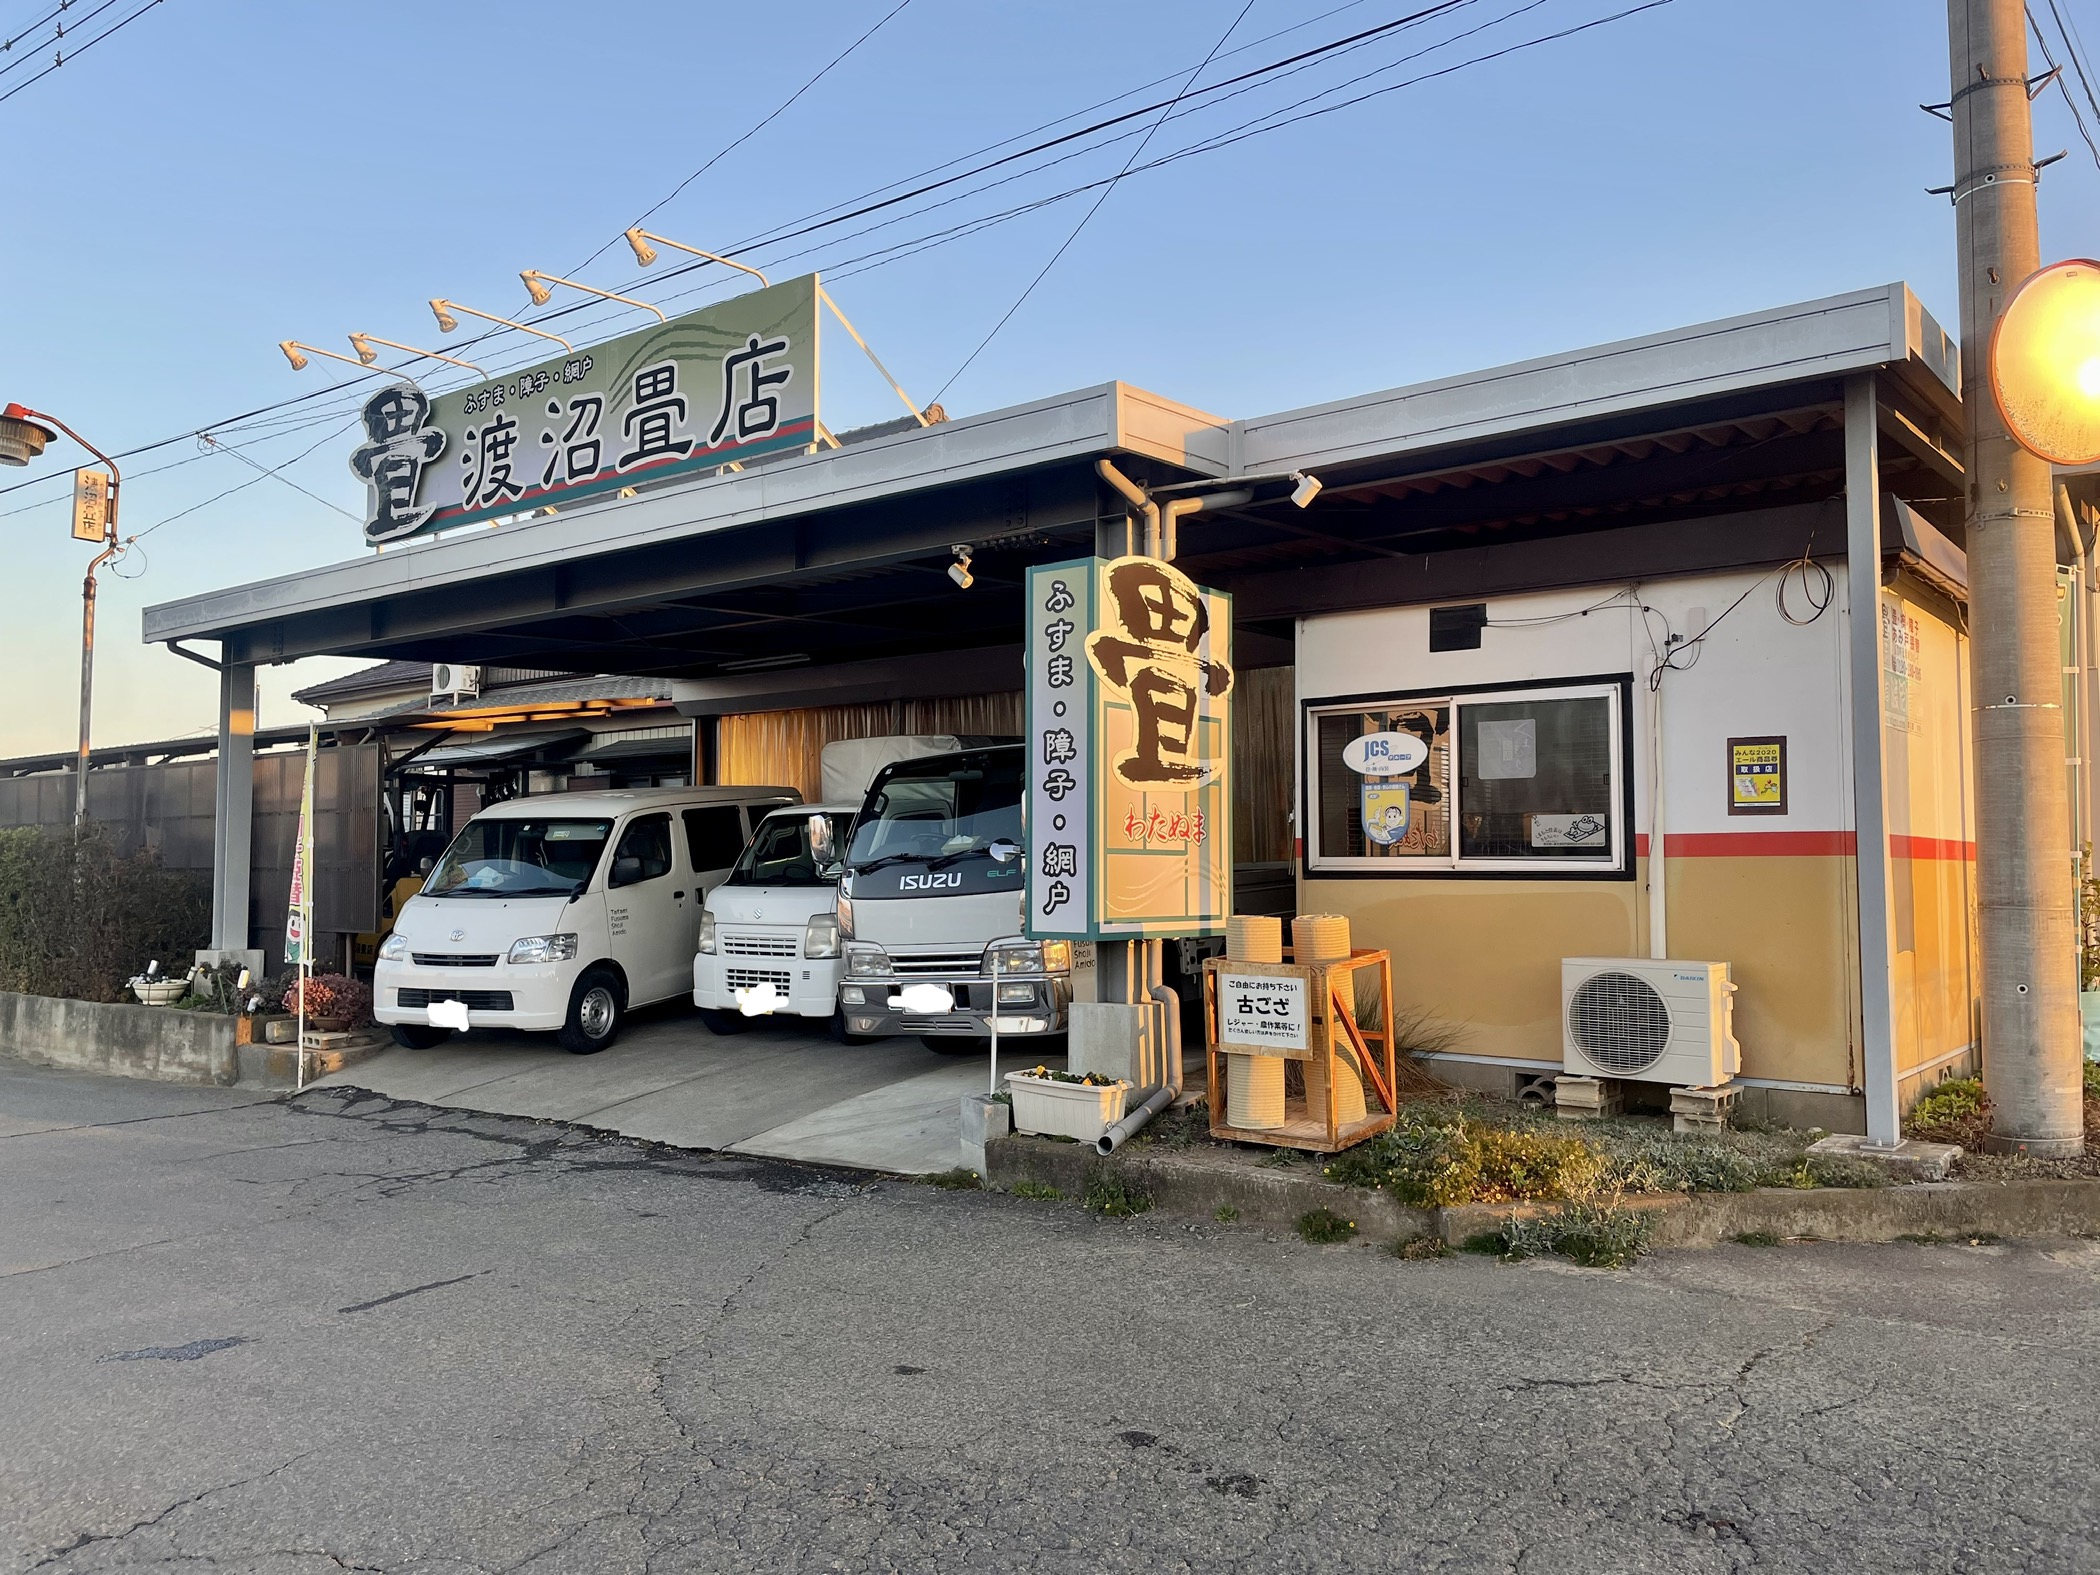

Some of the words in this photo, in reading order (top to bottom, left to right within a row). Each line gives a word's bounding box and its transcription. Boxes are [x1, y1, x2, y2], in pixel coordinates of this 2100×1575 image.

[464, 356, 594, 415] ふすま・障子・網戸
[462, 335, 792, 509] 渡沼畳店
[1043, 580, 1077, 915] ふすま・障子・網戸
[1363, 740, 1390, 762] JCS
[1124, 803, 1207, 845] わたぬま
[900, 873, 962, 890] ISUZU
[987, 869, 1017, 878] ELF
[1236, 994, 1290, 1016] 古ござ
